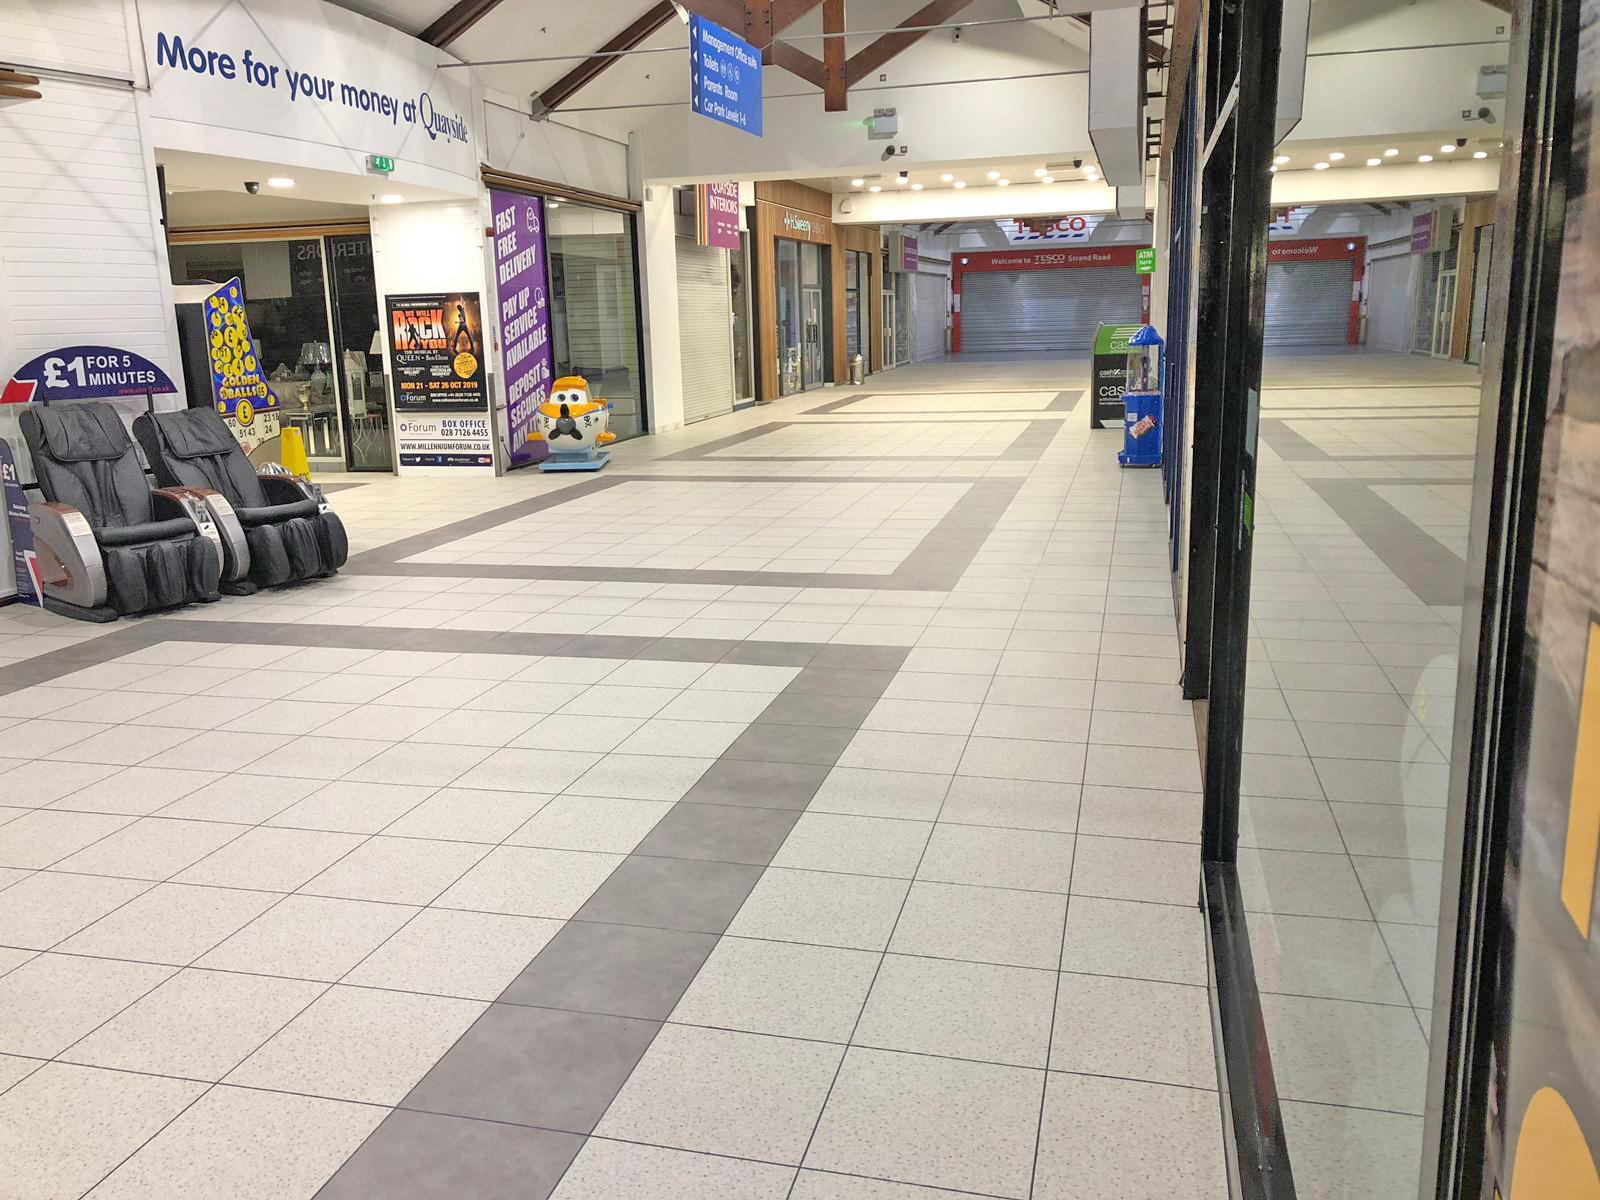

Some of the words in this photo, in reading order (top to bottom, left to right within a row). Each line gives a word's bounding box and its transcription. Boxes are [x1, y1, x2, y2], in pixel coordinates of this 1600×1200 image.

[703, 28, 734, 56] Management
[735, 46, 748, 64] Office
[703, 53, 719, 72] Toilets
[157, 32, 236, 79] More
[242, 49, 279, 88] for
[285, 69, 334, 102] your
[341, 83, 398, 125] money
[403, 99, 416, 123] at
[420, 92, 468, 143] Quayside
[704, 75, 723, 95] Parents
[725, 84, 738, 102] Room
[704, 97, 713, 113] Car
[714, 101, 725, 118] Park
[726, 106, 739, 123] Levels
[710, 194, 738, 215] INTERIORS
[496, 205, 516, 235] FAST
[1013, 217, 1087, 234] TCO
[498, 231, 517, 260] FREE
[1034, 254, 1066, 264] TESCO
[1068, 254, 1092, 262] Strand
[1138, 251, 1153, 259] ATM
[499, 244, 536, 286] DELIVERY
[502, 294, 517, 322] PAY
[519, 286, 530, 310] UP
[504, 305, 538, 346] SERVICE
[420, 339, 448, 350] YOU
[506, 323, 547, 371] AVAILABLE
[1110, 340, 1129, 350] cas
[396, 354, 420, 364] QUEEN
[43, 356, 87, 388] £1
[87, 356, 118, 369] FOR
[123, 355, 131, 367] 5
[89, 370, 156, 386] MINUTES
[222, 374, 260, 387] GOLDEN
[401, 382, 415, 390] MON
[463, 381, 478, 389] 2019
[509, 363, 541, 406] DEPOSIT
[228, 386, 257, 399] BALLS
[1099, 385, 1126, 397] cas
[511, 384, 546, 428] SECURES
[263, 413, 271, 423] 23
[442, 420, 457, 428] BOX
[460, 420, 486, 428] OFFICE
[248, 427, 256, 436] 43
[265, 425, 272, 434] 24
[408, 422, 437, 432] Forum
[441, 429, 453, 437] 028
[455, 429, 471, 437] 7126
[472, 428, 489, 437] 4455
[513, 421, 528, 453] ANY
[400, 443, 491, 451] WWW.MILLENNIUMFORUM.CO.UK
[2, 463, 16, 481] £1
